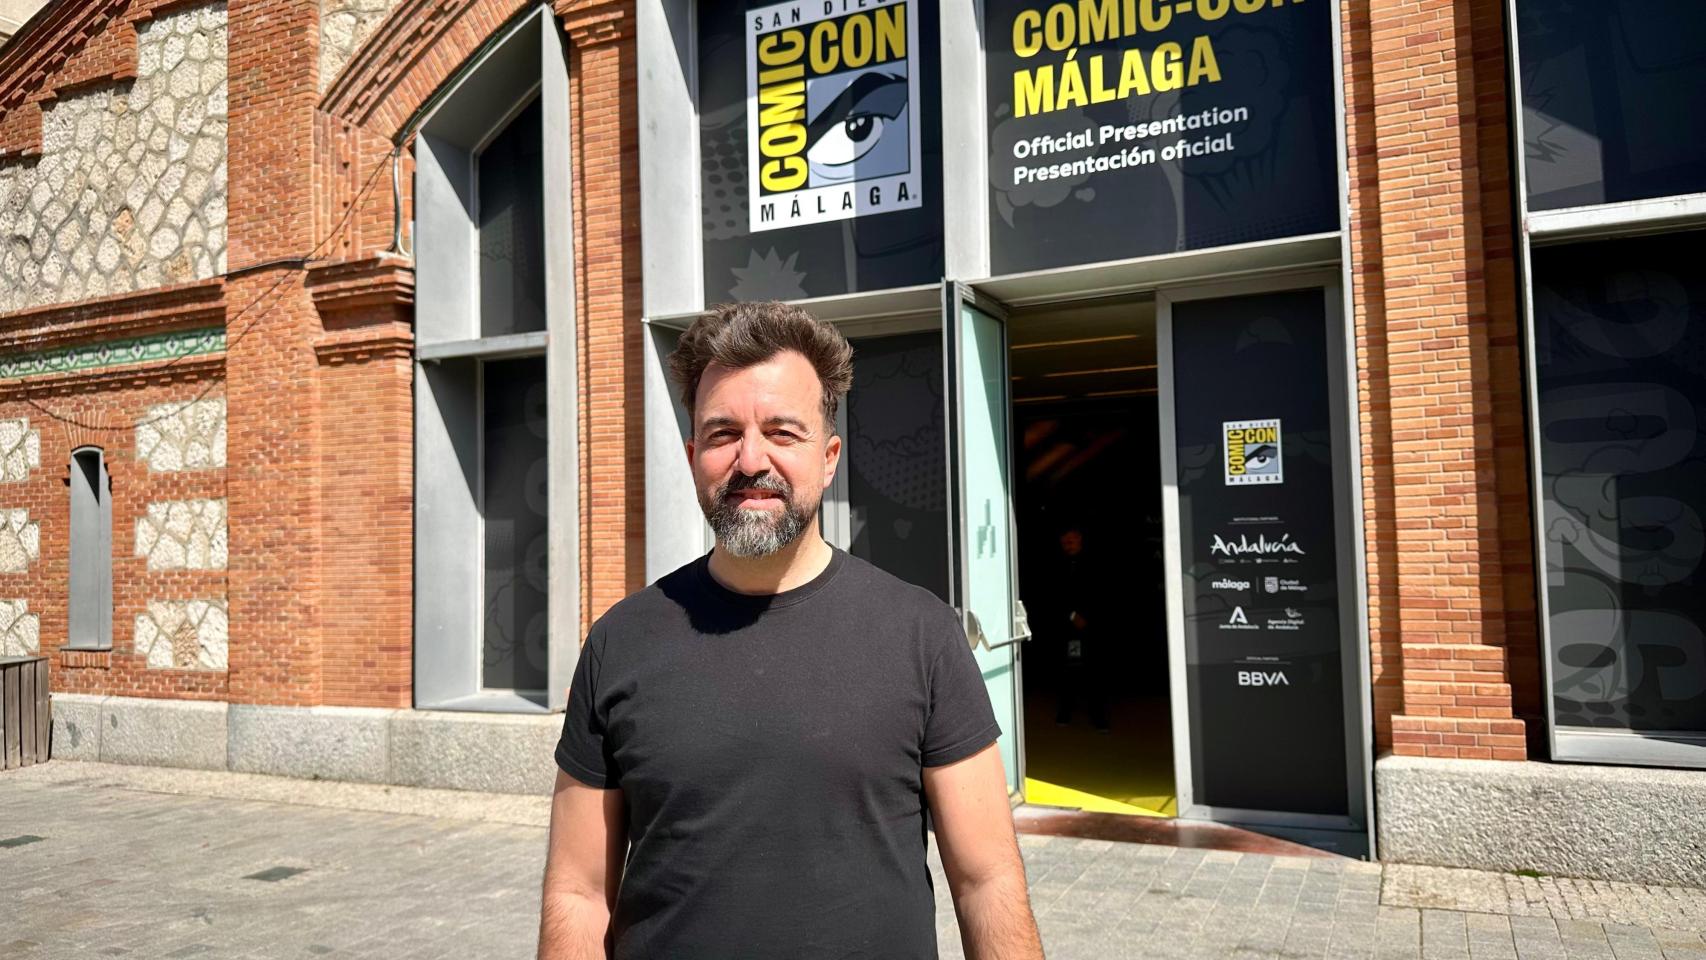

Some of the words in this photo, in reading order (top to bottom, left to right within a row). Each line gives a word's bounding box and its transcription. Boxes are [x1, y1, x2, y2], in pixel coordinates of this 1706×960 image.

[754, 8, 801, 31] SAN
[809, 4, 907, 75] CON
[1013, 35, 1222, 118] MÁLAGA
[758, 29, 809, 193] COMIC
[1013, 128, 1095, 159] Official
[1099, 106, 1249, 145] Presentation
[1013, 146, 1156, 185] Presentación
[1161, 133, 1234, 162] oficial
[761, 182, 910, 222] MÁLAGA
[1228, 430, 1246, 475] COMIC
[1244, 429, 1276, 443] CON
[1210, 533, 1306, 556] Andalucía
[1212, 578, 1250, 591] málaga
[1238, 671, 1290, 687] BBVA
